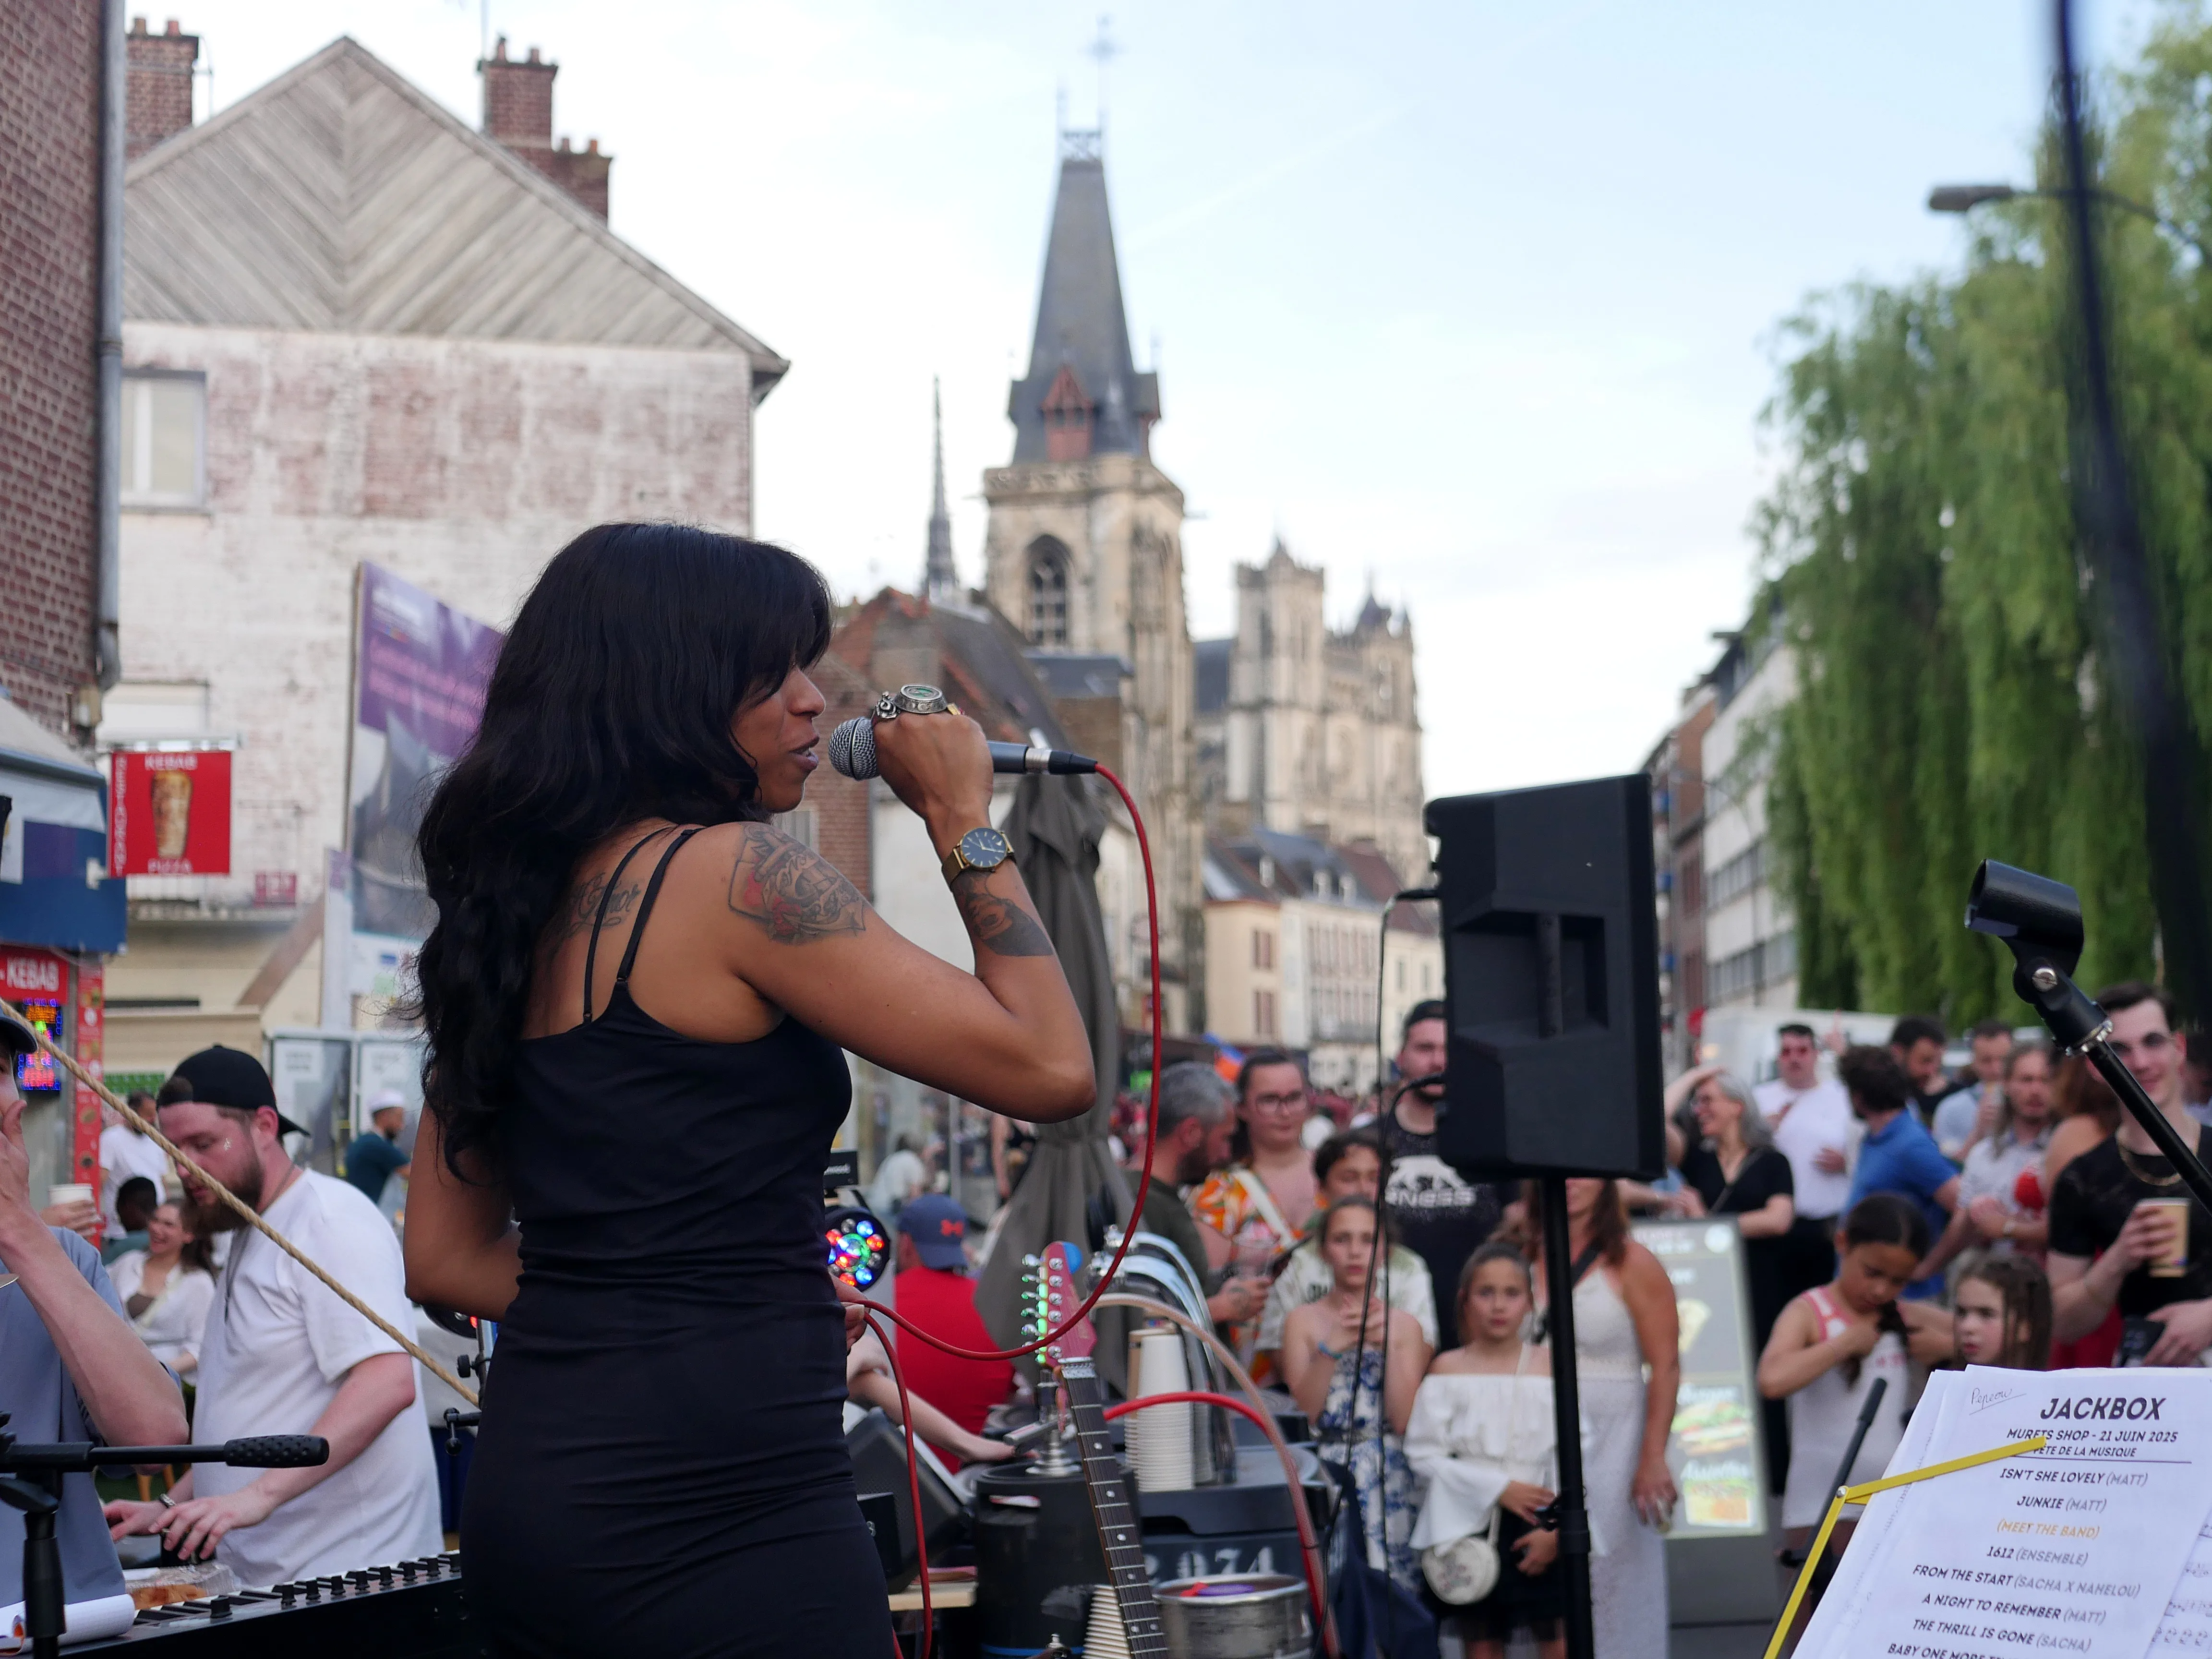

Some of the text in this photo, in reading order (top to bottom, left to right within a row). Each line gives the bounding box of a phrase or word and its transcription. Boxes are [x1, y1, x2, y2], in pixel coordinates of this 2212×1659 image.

[6, 958, 60, 992] KEBAB
[2040, 1397, 2166, 1420] JACKBOX
[2056, 1430, 2090, 1441] SHOP
[2099, 1431, 2111, 1442] 21
[2115, 1431, 2146, 1443] JUIN
[2147, 1431, 2178, 1443] 2025
[2058, 1446, 2072, 1456] DE
[2074, 1447, 2086, 1456] LA
[2089, 1447, 2137, 1457] MUSIQUE
[2000, 1468, 2149, 1487] ISN'T SHE LOVELY (MATT)
[2017, 1496, 2107, 1514] JUNKIE (MATT)
[1997, 1518, 2100, 1540] (MEET THE BAND)
[1987, 1546, 2089, 1567] 1612 (ENSEMBLE)
[1913, 1564, 1949, 1579] FROM
[1951, 1568, 1973, 1581] THE
[1975, 1572, 2013, 1586] START
[2014, 1574, 2061, 1592] (SACHA
[2065, 1581, 2075, 1593] X
[1922, 1593, 2106, 1626] A NIGHT TO REMEMBER (MATT)
[1913, 1619, 2092, 1653] THE THRILL IS GONE (SACHA)
[1887, 1643, 1920, 1656] BABY
[1921, 1647, 1948, 1659] ONE
